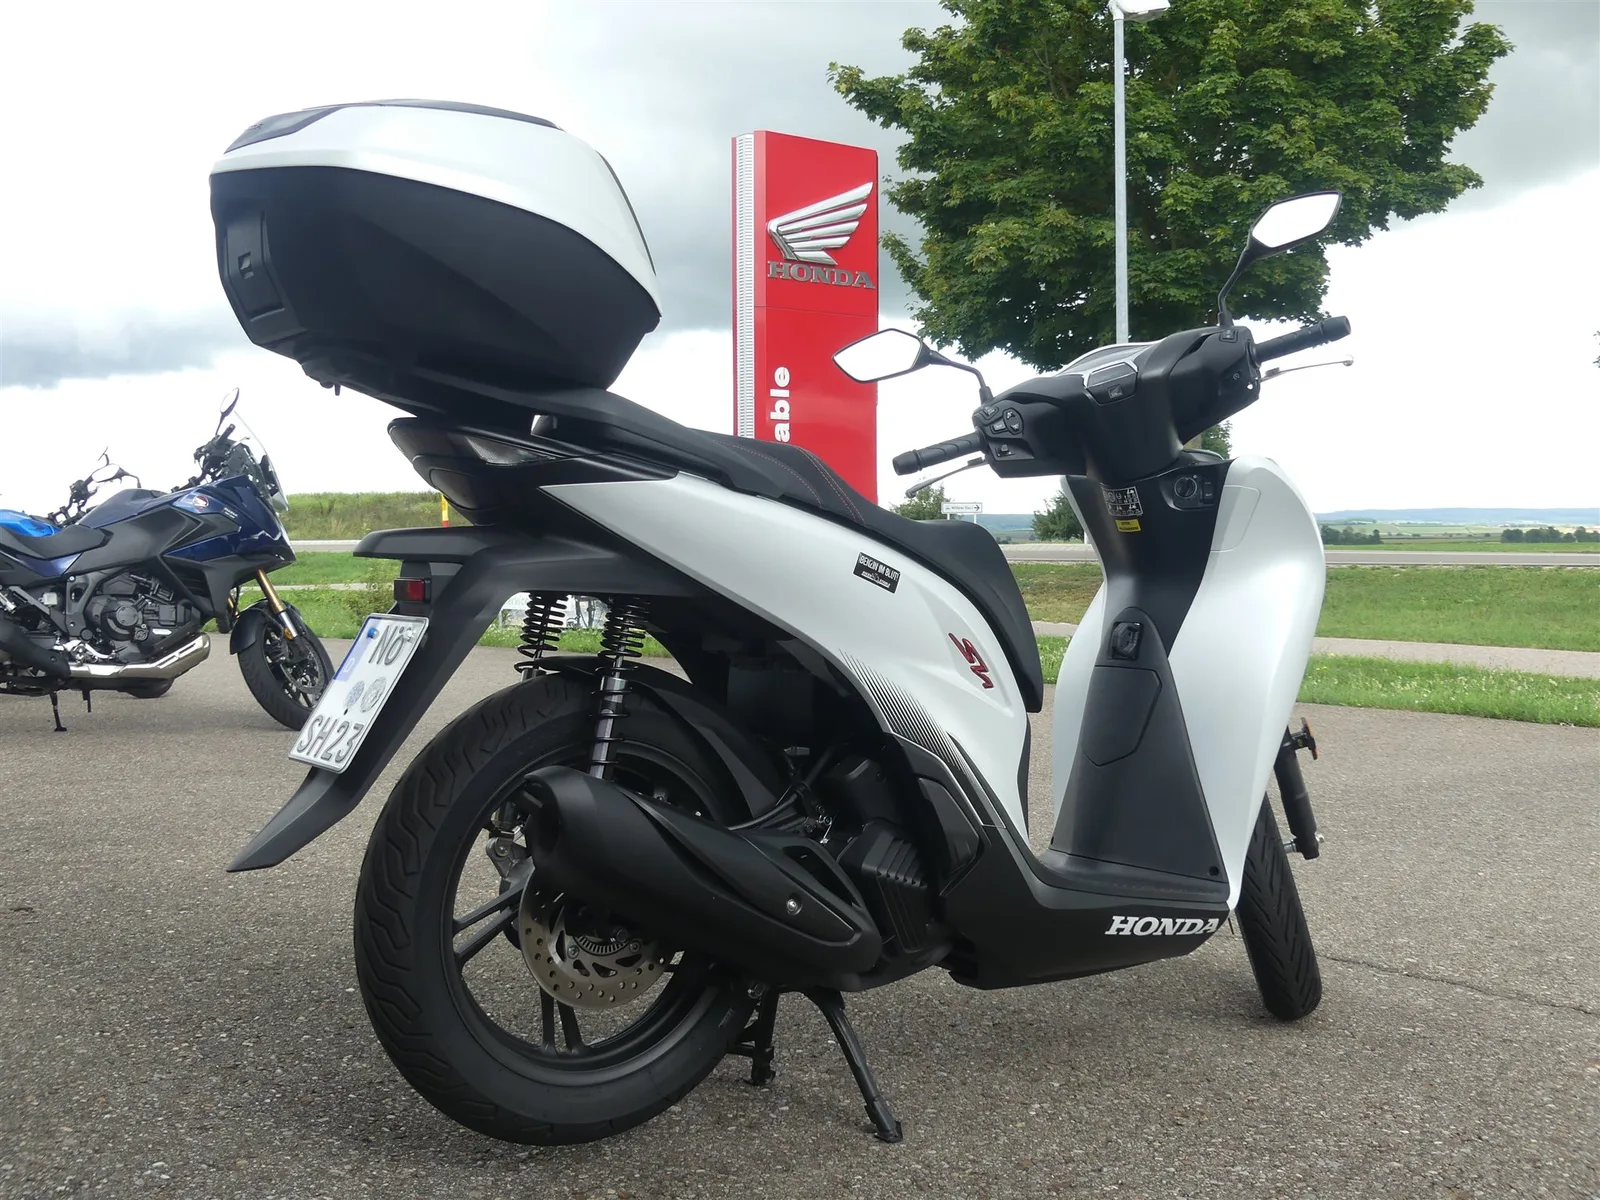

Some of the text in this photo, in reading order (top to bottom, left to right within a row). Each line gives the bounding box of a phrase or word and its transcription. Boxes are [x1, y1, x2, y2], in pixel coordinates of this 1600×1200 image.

[767, 260, 876, 290] HONDA
[770, 366, 790, 443] able
[1104, 915, 1220, 936] HONDA
